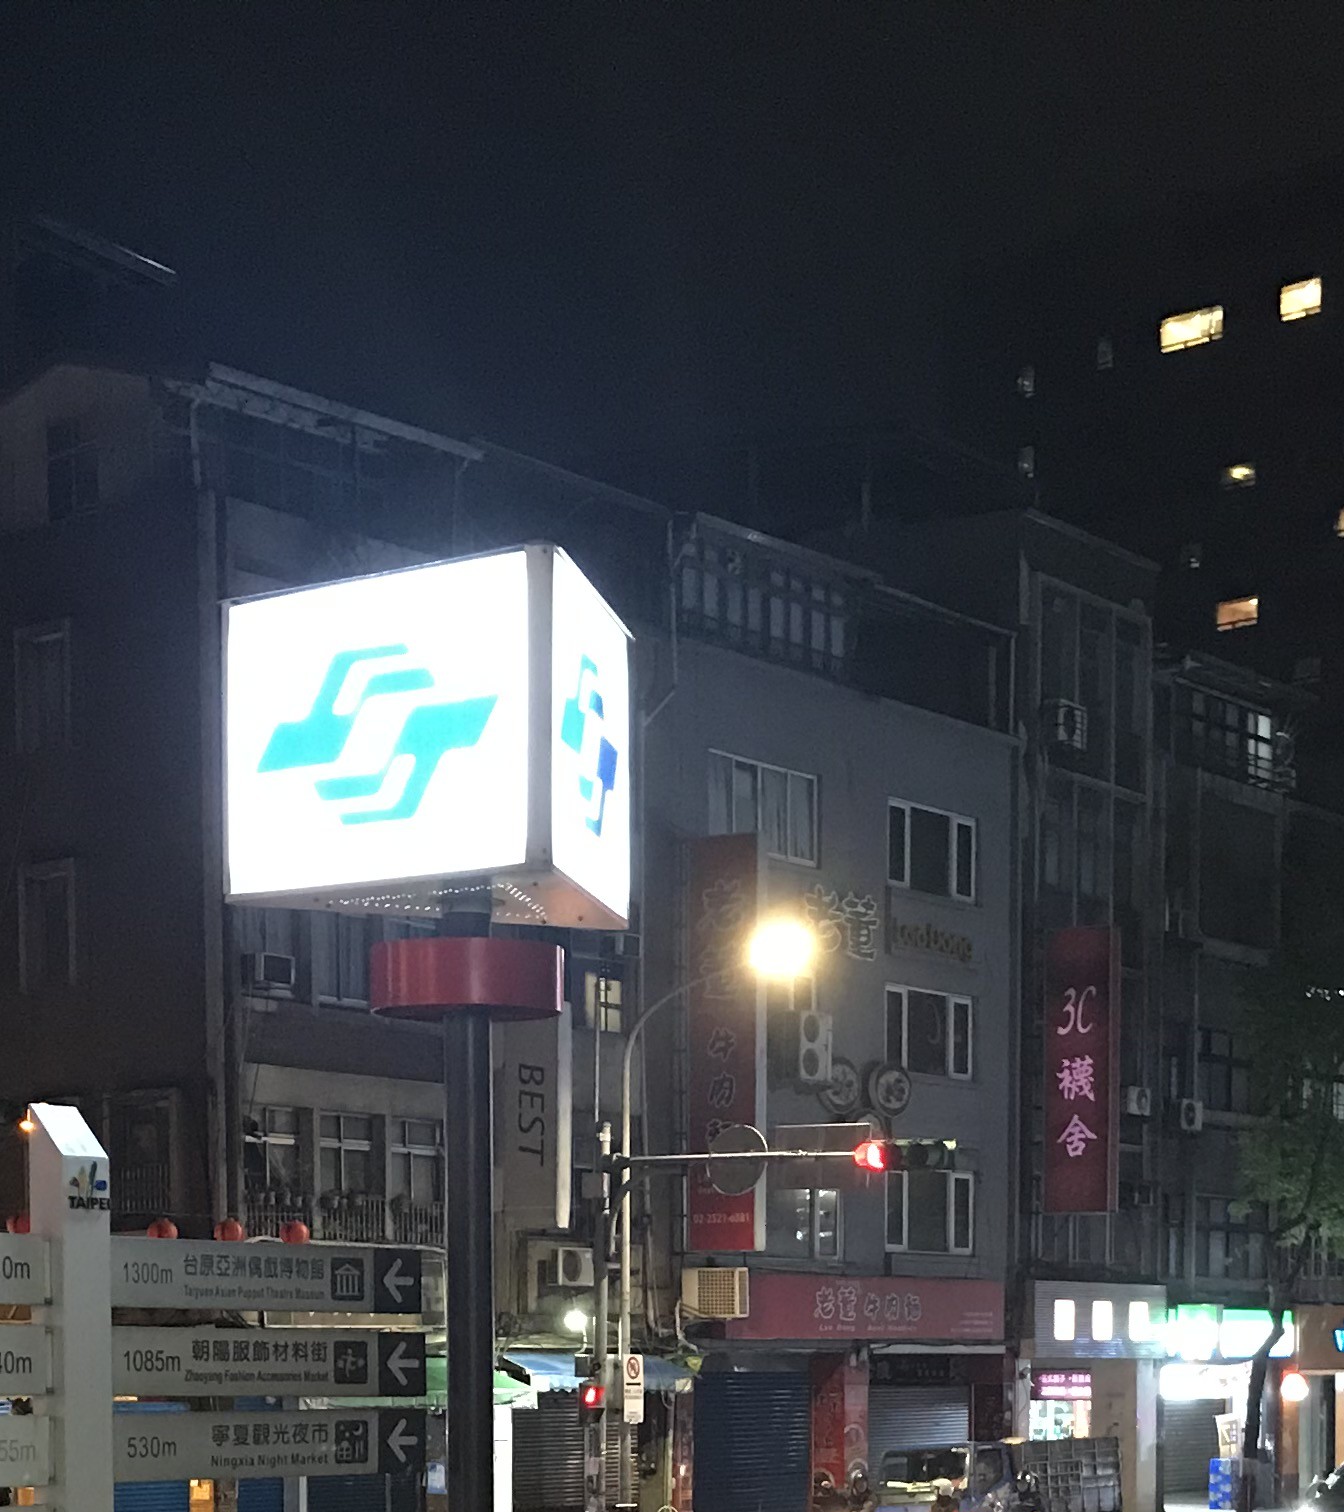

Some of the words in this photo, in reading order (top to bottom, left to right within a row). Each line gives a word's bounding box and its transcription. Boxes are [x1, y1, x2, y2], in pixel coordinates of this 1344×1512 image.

[518, 1063, 545, 1167] BEST
[123, 1262, 173, 1284] 1300m
[123, 1350, 180, 1372] 1085m
[191, 1339, 327, 1362] 朝陽服飾材料街
[211, 1423, 328, 1447] 寧夏觀光夜市
[127, 1436, 176, 1458] 530m
[211, 1455, 254, 1469] Ningxia
[258, 1454, 288, 1468] Night
[291, 1453, 328, 1466] Market
